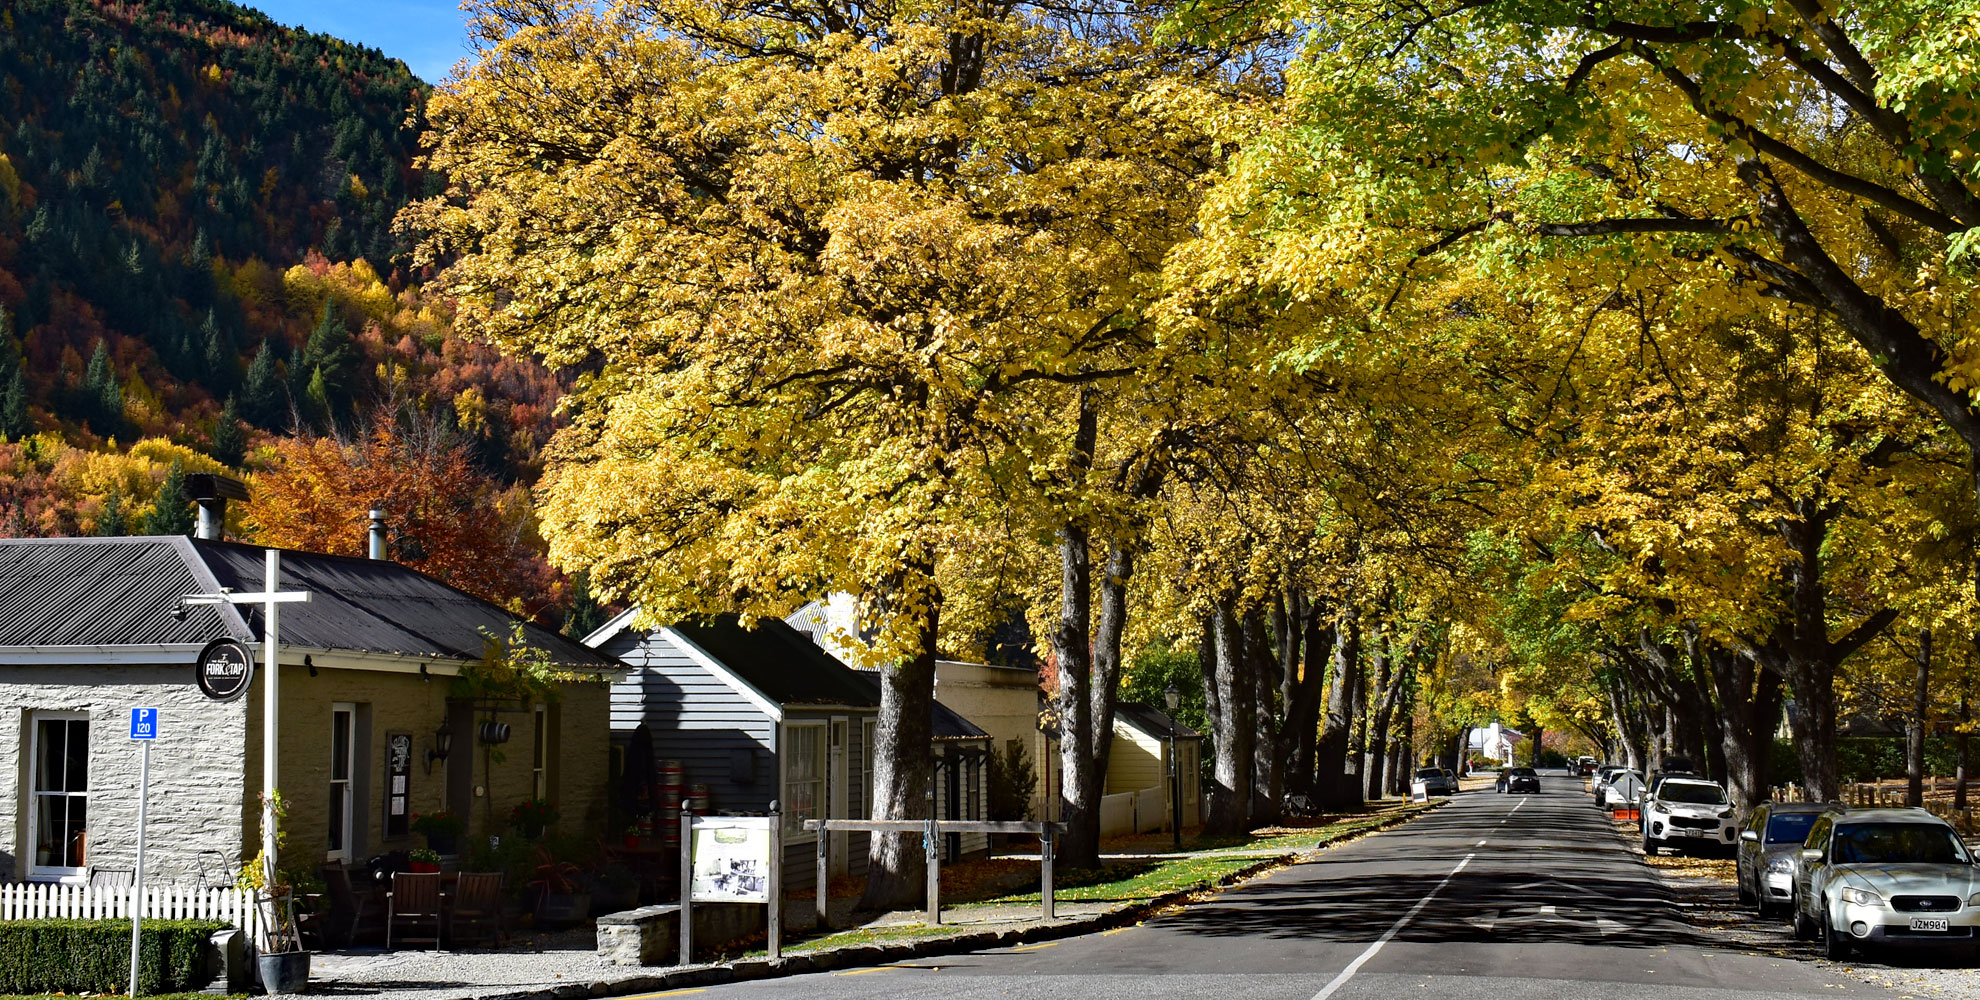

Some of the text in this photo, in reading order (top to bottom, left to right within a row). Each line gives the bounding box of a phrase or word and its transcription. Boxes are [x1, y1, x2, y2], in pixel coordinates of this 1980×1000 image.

[206, 663, 225, 676] FORK
[229, 663, 244, 676] TAP
[139, 709, 149, 722] P
[137, 723, 151, 733] 120
